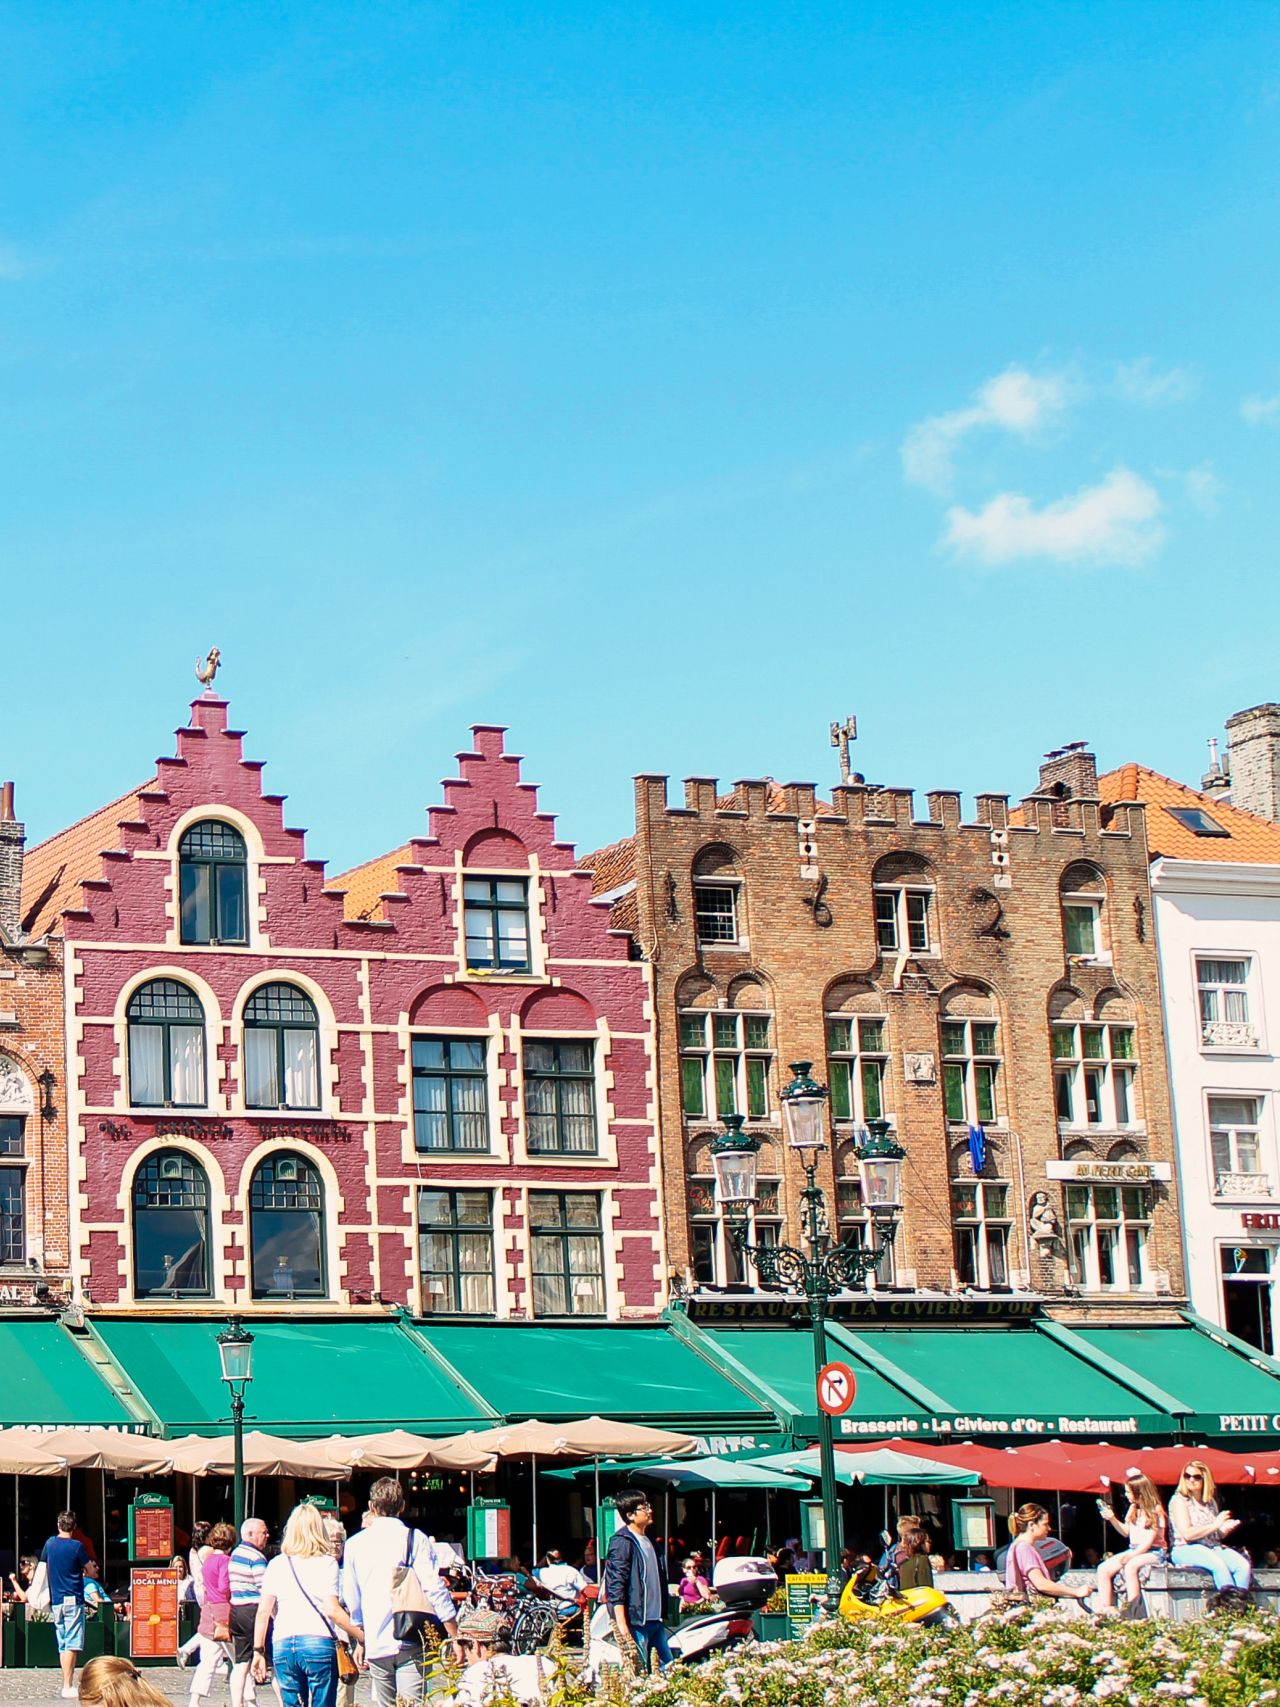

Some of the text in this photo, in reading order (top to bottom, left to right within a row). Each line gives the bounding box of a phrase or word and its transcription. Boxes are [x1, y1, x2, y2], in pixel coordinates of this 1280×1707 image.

[693, 1302, 838, 1317] RESTAURAT
[849, 1302, 878, 1316] LA
[840, 1417, 918, 1434] Brasserie
[931, 1417, 952, 1432] La
[1011, 1418, 1045, 1433] d'Or
[1058, 1416, 1137, 1433] Restaurant
[1219, 1414, 1268, 1432] PETIT
[694, 1435, 756, 1455] ARTS
